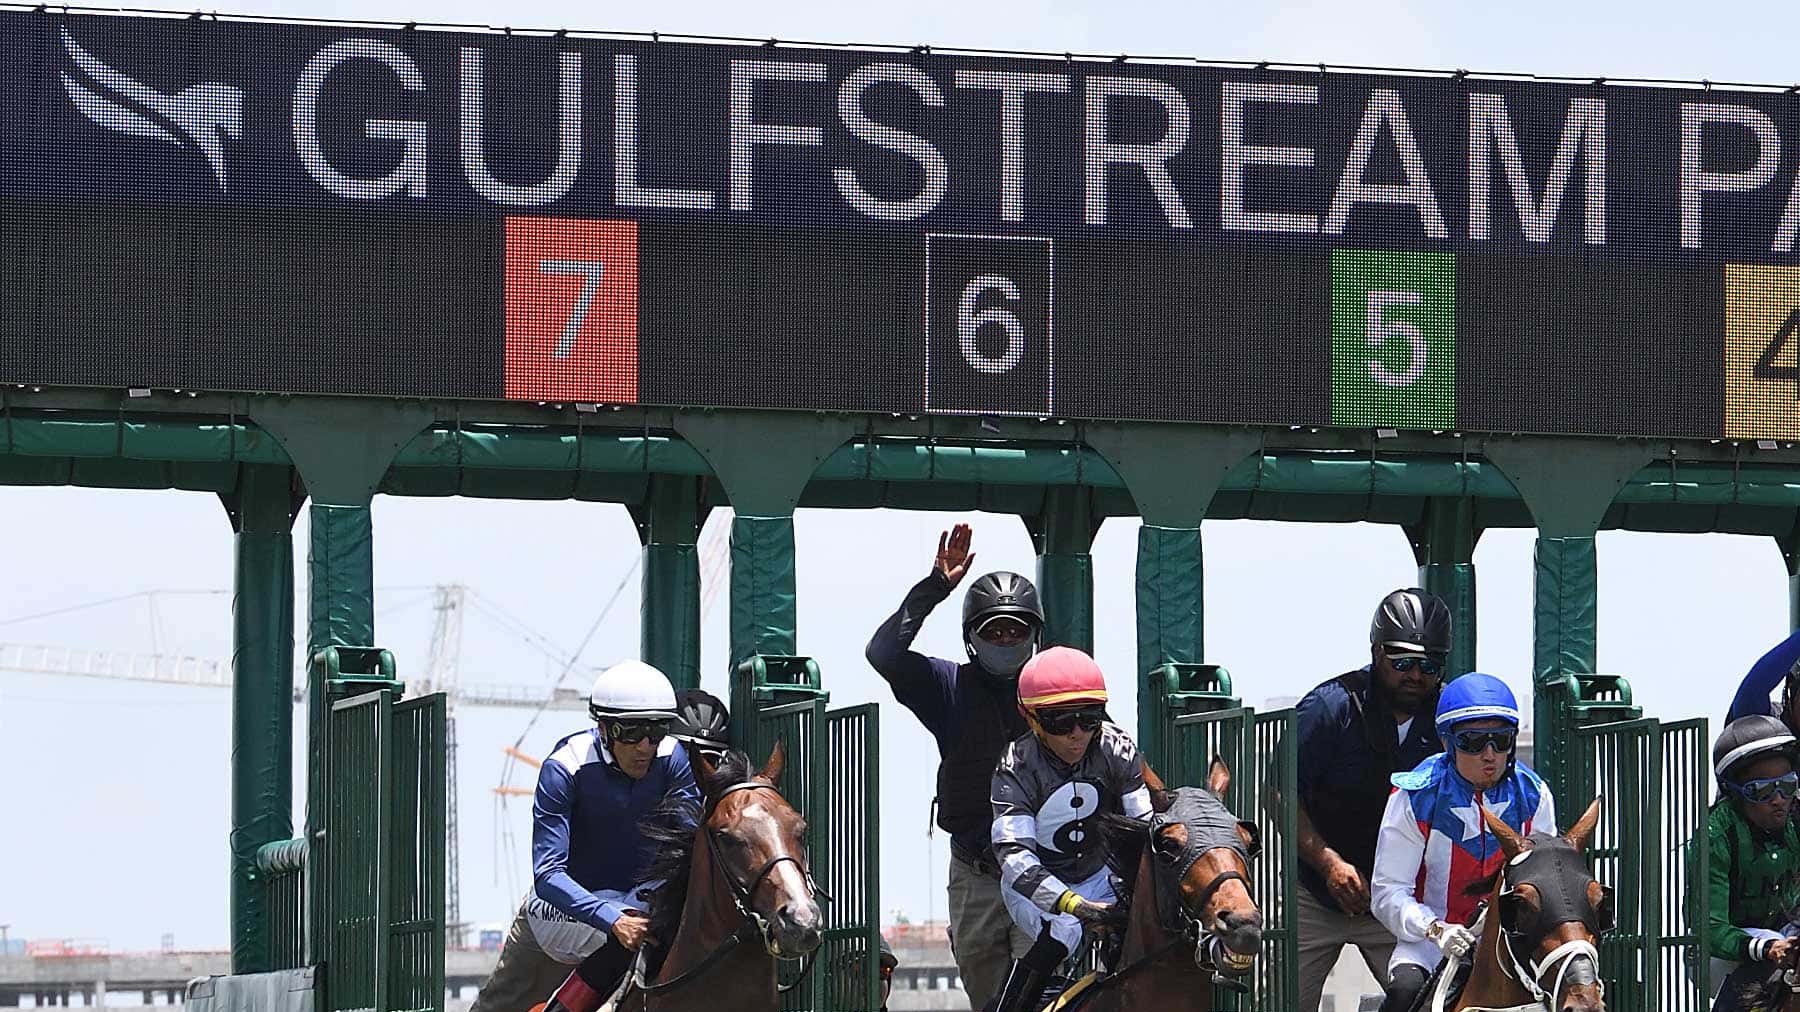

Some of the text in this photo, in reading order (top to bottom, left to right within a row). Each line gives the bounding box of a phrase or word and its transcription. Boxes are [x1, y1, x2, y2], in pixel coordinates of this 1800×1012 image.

[292, 37, 1607, 246] GULFSTREAM
[539, 260, 604, 359] 7
[957, 274, 1024, 374] 6
[1364, 289, 1430, 388] 5
